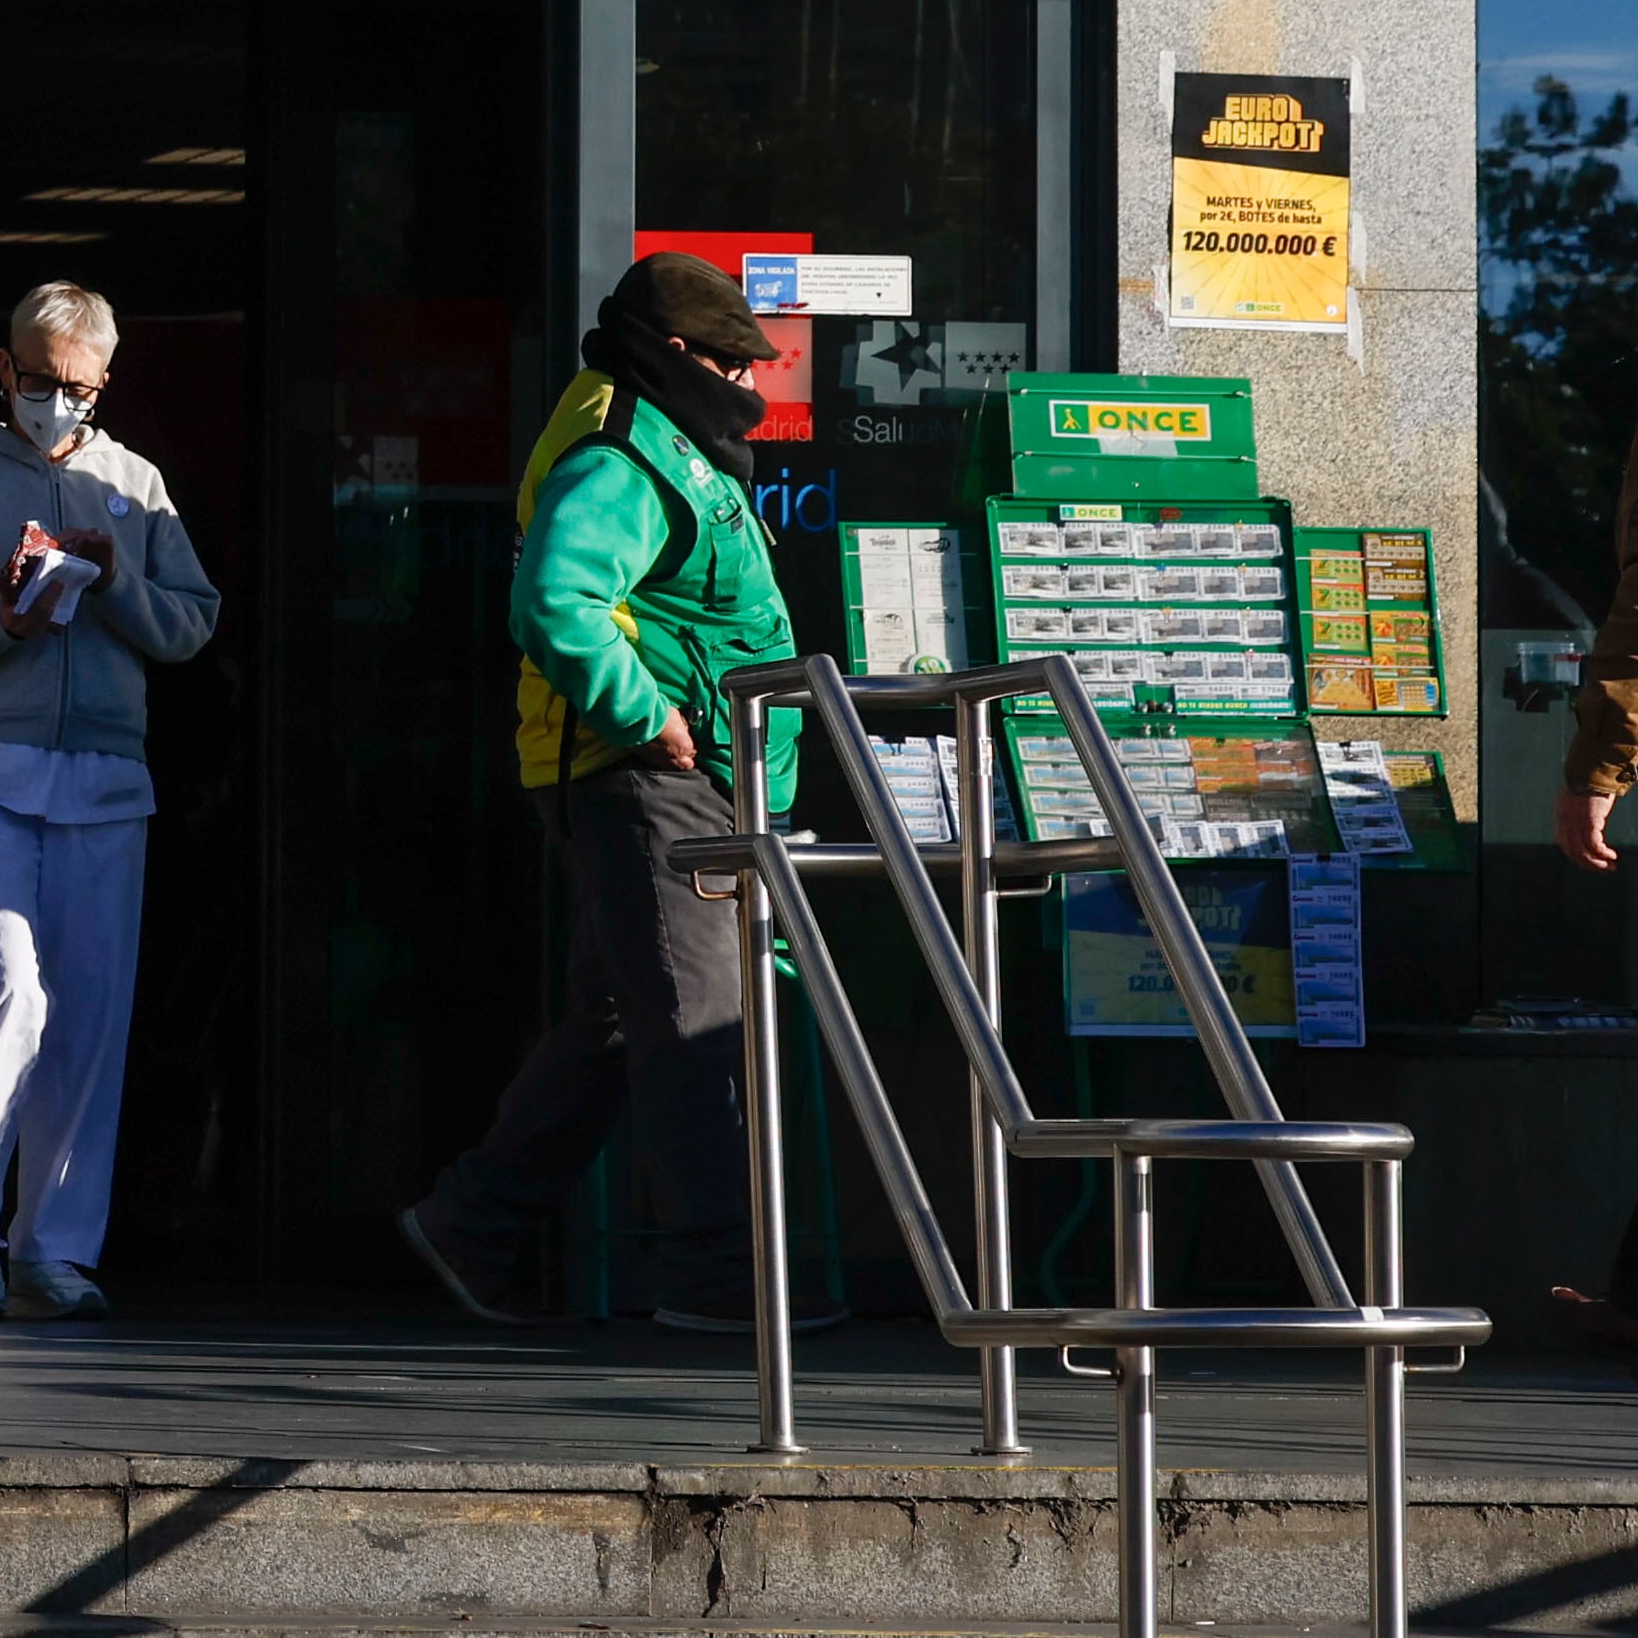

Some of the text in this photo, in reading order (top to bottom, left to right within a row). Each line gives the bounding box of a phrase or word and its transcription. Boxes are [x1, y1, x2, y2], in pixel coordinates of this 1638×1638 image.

[1225, 94, 1297, 122] EURO
[1202, 119, 1319, 151] JACKPOT
[1206, 196, 1316, 212] MARTES y VIERNES,
[1200, 211, 1322, 224] por 2€, BOTES de hasta
[1182, 230, 1337, 257] 120.000.000 €
[1097, 410, 1199, 433] ONCE
[1078, 508, 1118, 517] ONCE
